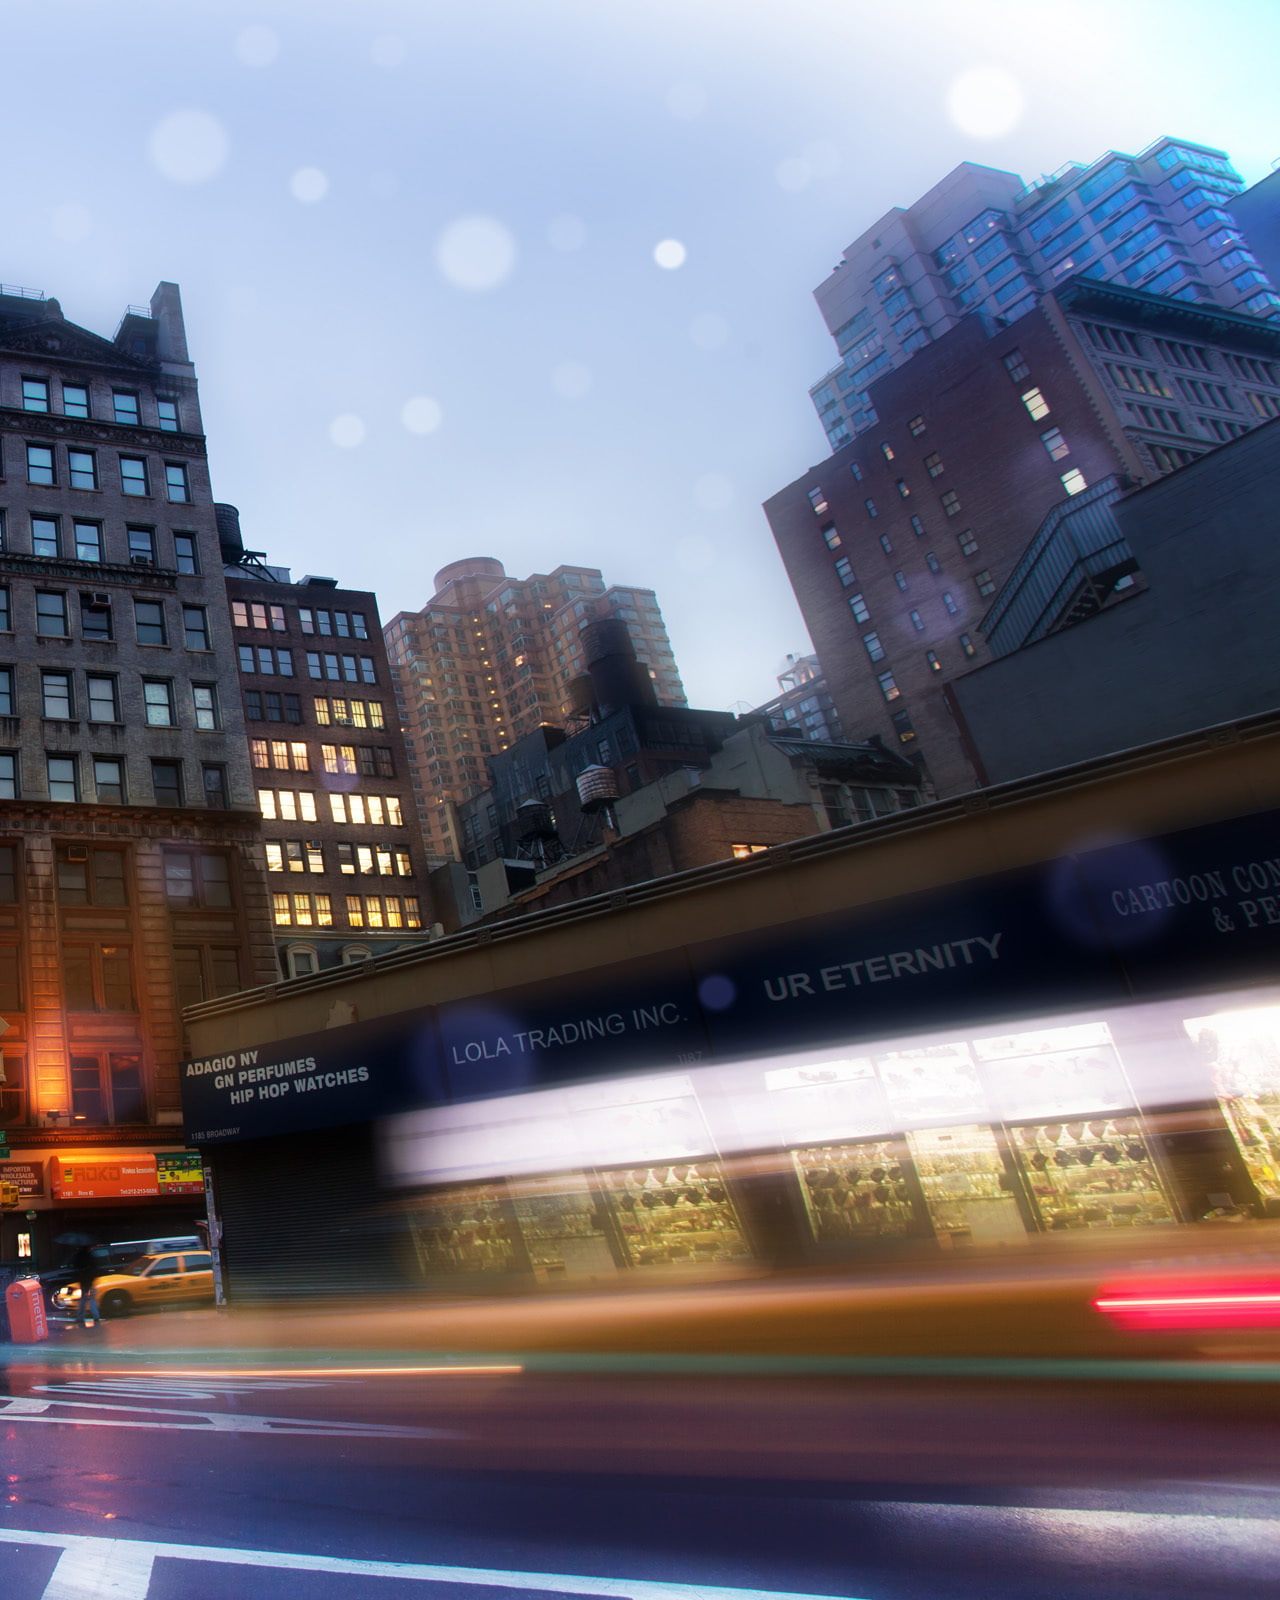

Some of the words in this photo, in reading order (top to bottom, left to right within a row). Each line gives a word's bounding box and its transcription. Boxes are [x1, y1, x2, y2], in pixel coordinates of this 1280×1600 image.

[1111, 870, 1228, 916] CARTOON
[1211, 906, 1235, 933] &
[763, 972, 816, 1001] UR
[820, 932, 1003, 992] ETERNITY
[452, 1036, 512, 1065] LOLA
[513, 1013, 626, 1053] TRADING
[632, 1002, 689, 1031] INC.
[185, 1055, 237, 1077] ADAGIO
[240, 1050, 259, 1066] NY
[214, 1073, 234, 1090] GN
[238, 1056, 317, 1085] PERFUMES
[230, 1089, 254, 1105] HIP
[258, 1082, 290, 1100] HOP
[294, 1066, 370, 1093] WATCHES
[191, 1130, 206, 1141] 1185
[206, 1126, 241, 1139] BROADWAY
